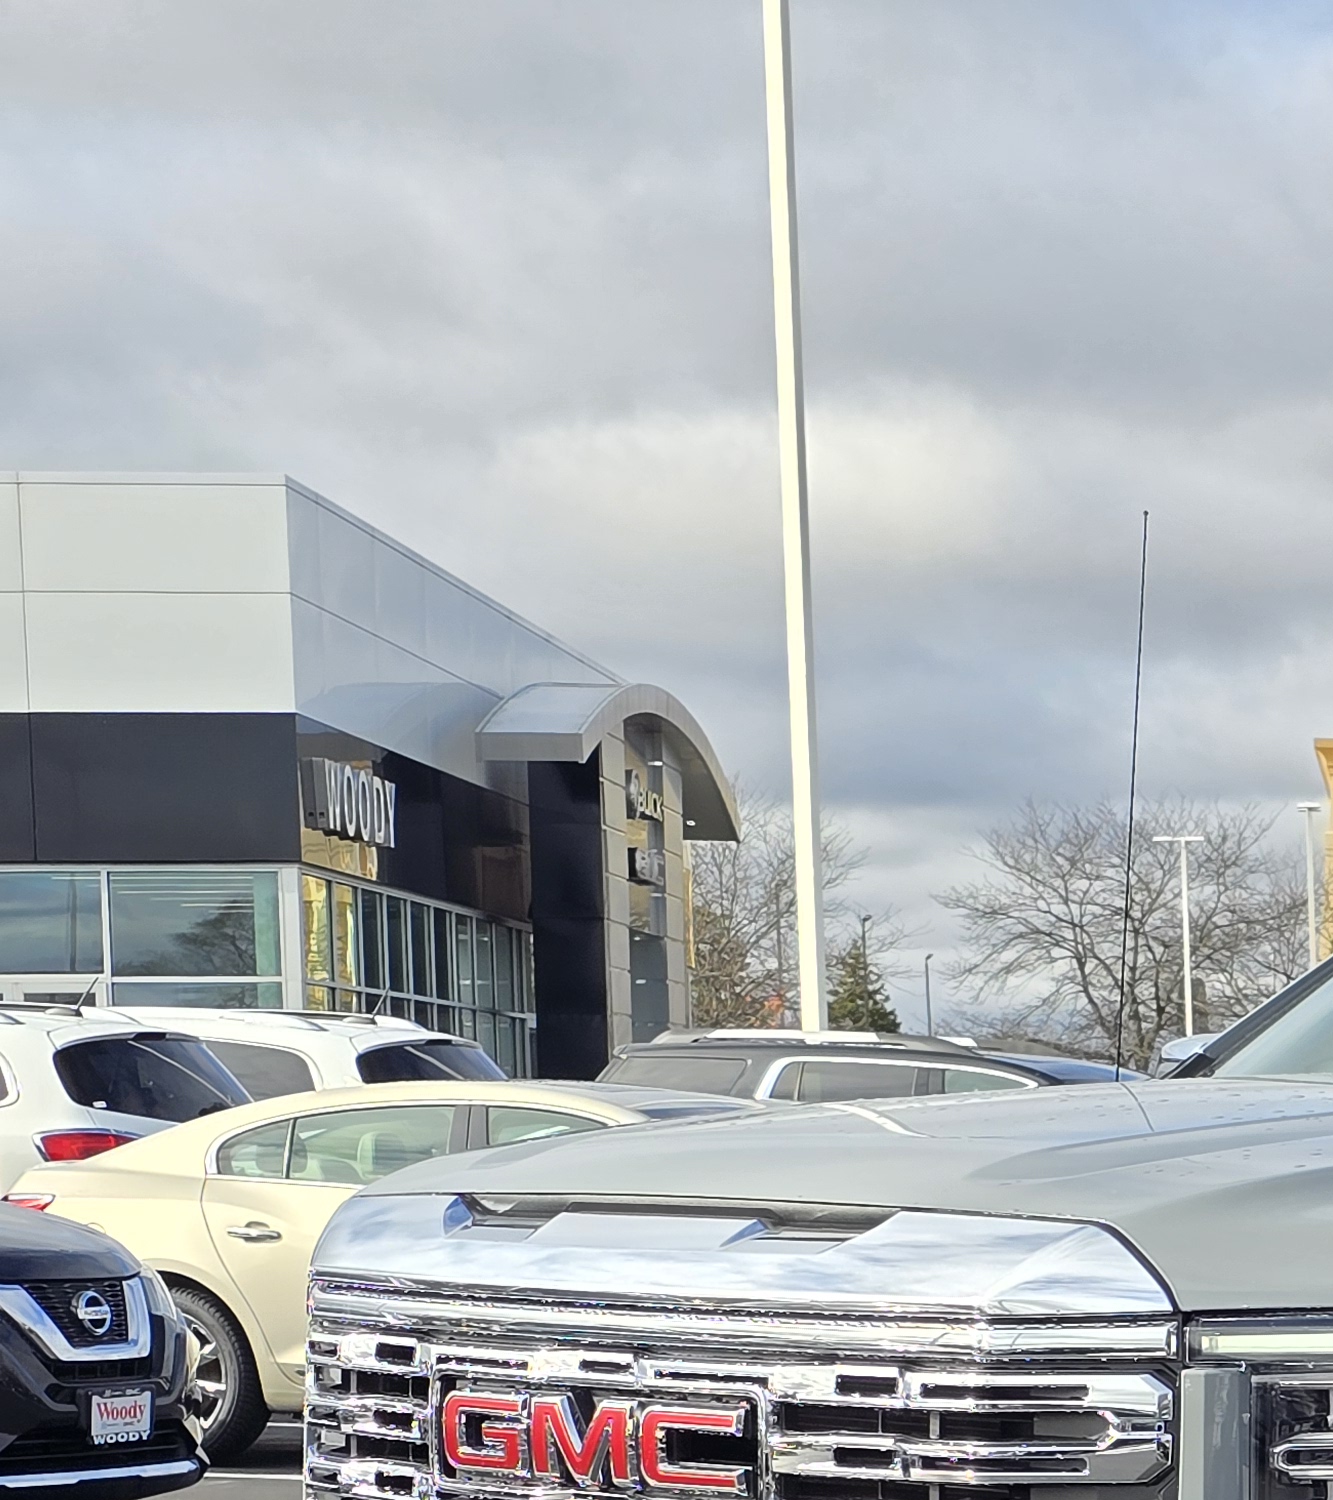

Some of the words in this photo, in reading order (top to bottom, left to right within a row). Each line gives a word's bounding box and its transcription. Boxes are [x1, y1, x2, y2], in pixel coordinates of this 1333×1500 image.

[324, 758, 395, 848] WOODY
[93, 1429, 151, 1445] WOODY
[96, 1400, 146, 1424] Woody
[443, 1392, 748, 1497] GMC
